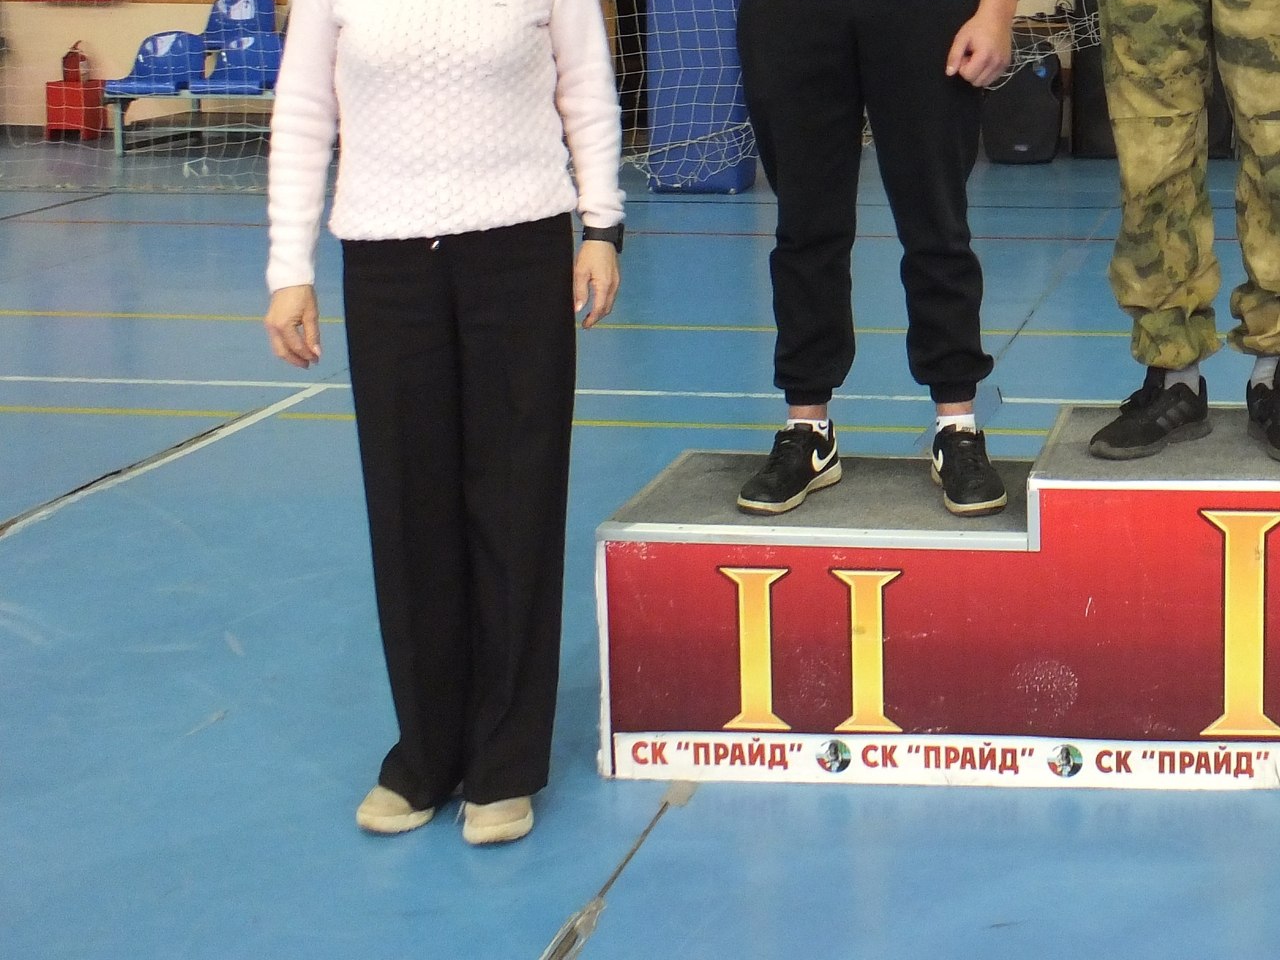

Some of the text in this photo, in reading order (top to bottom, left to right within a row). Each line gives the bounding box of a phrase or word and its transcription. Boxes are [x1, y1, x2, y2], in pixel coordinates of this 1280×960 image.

[631, 742, 669, 765] СК
[861, 744, 899, 768] СК
[1095, 749, 1132, 774] СК
